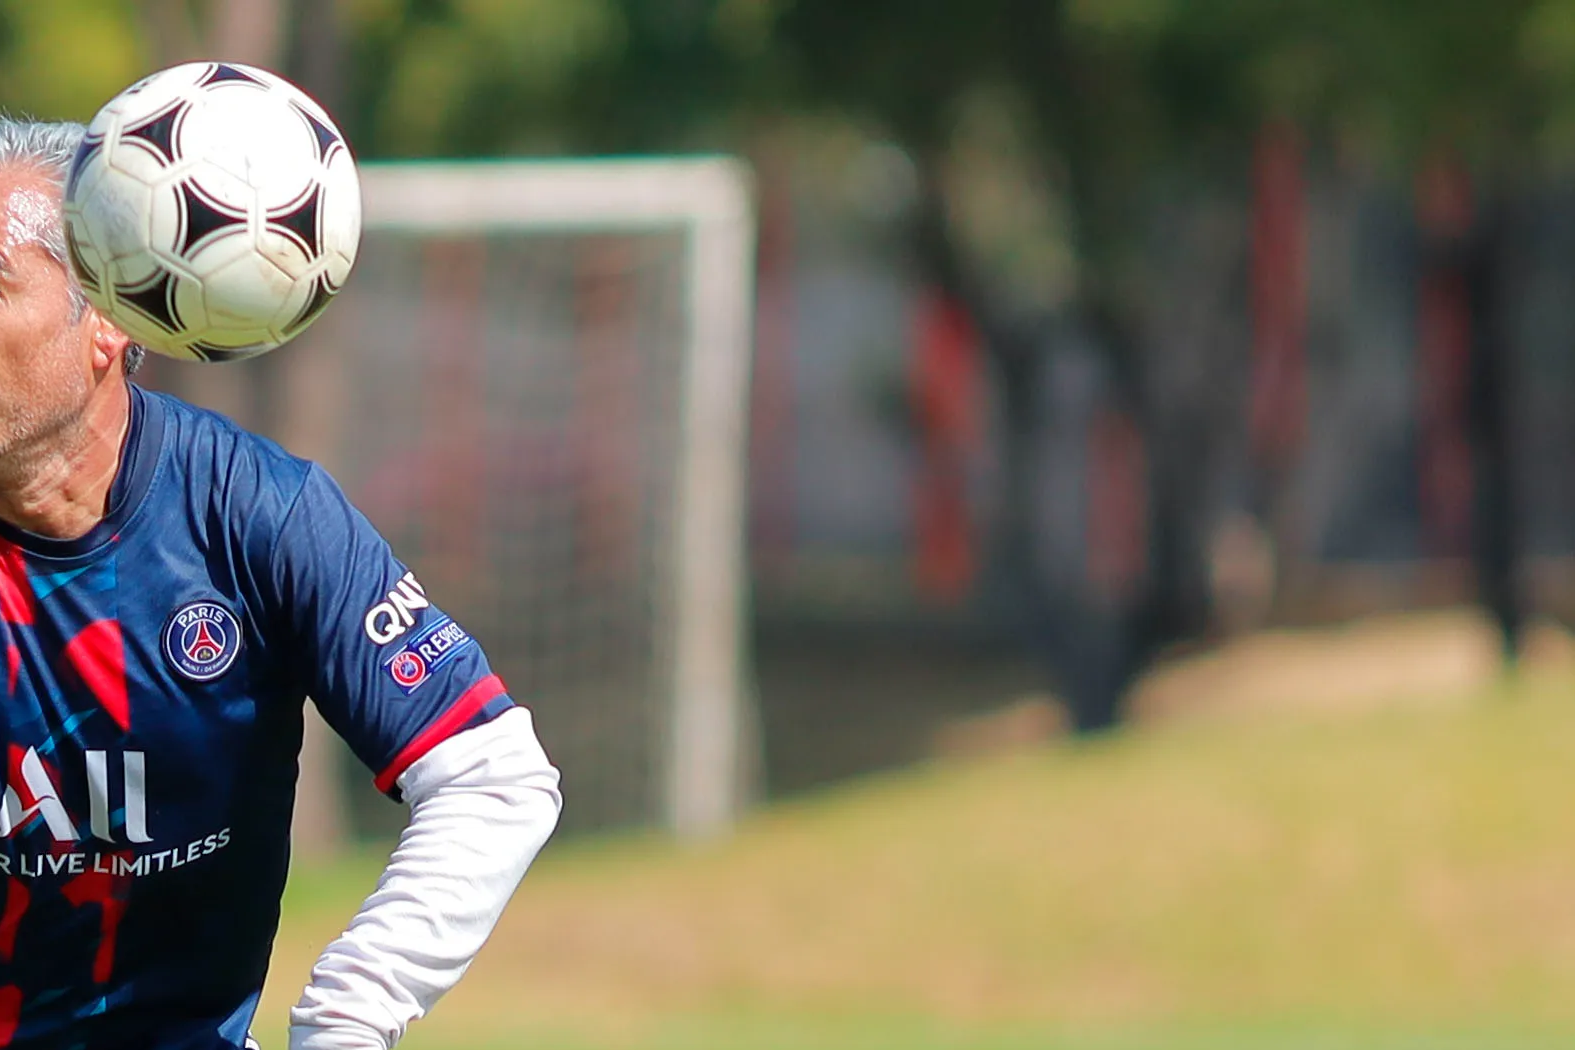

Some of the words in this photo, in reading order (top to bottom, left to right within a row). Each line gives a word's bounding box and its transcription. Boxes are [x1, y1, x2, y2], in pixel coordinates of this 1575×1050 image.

[177, 607, 225, 627] PARIS
[20, 852, 86, 877] LIVE
[93, 827, 232, 877] LIMITLESS
